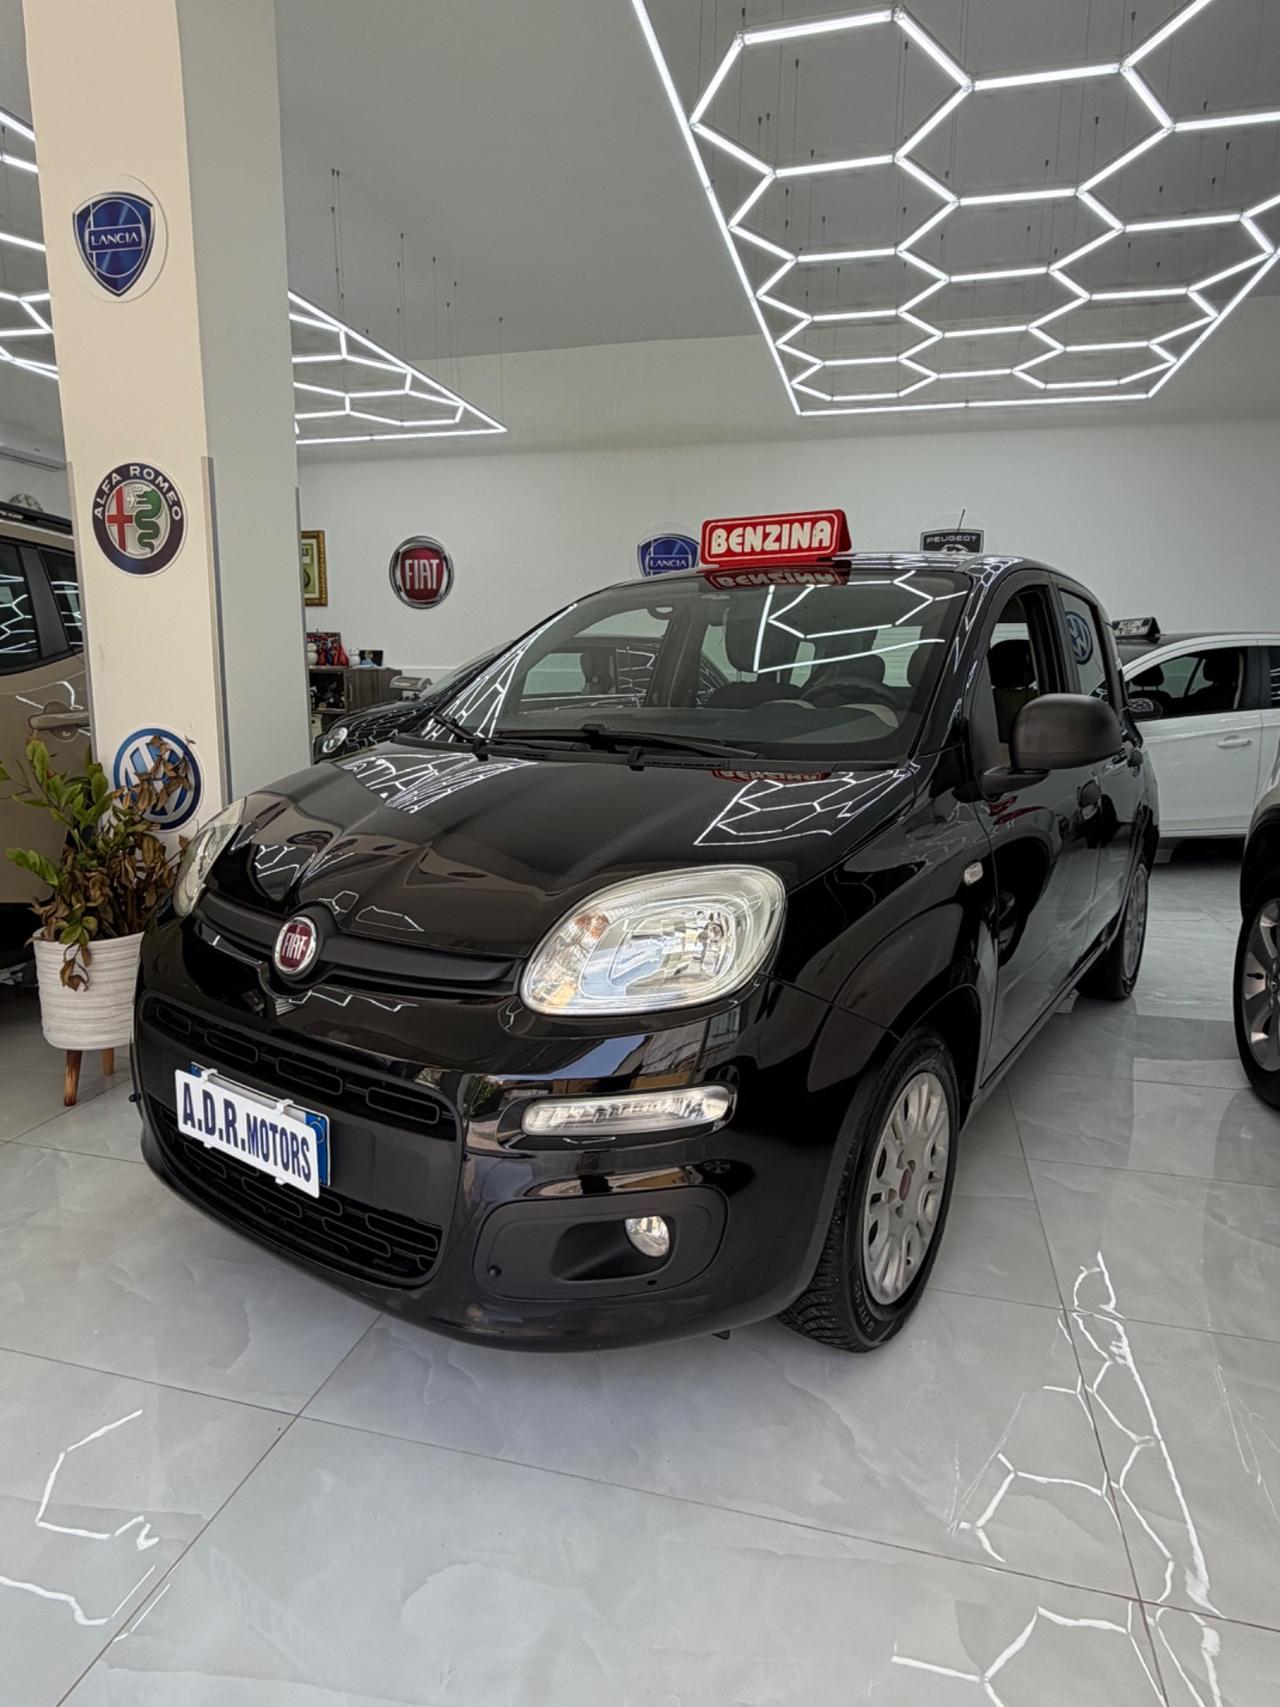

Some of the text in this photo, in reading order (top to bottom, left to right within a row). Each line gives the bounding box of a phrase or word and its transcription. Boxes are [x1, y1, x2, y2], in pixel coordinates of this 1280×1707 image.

[91, 232, 139, 246] LANCIA
[94, 465, 181, 521] ALFA ROMEO
[711, 519, 832, 555] BENZINA
[927, 534, 978, 544] PEUGEOT
[404, 559, 439, 590] FIAT
[650, 558, 686, 568] LANCIA
[281, 932, 309, 960] FIAT
